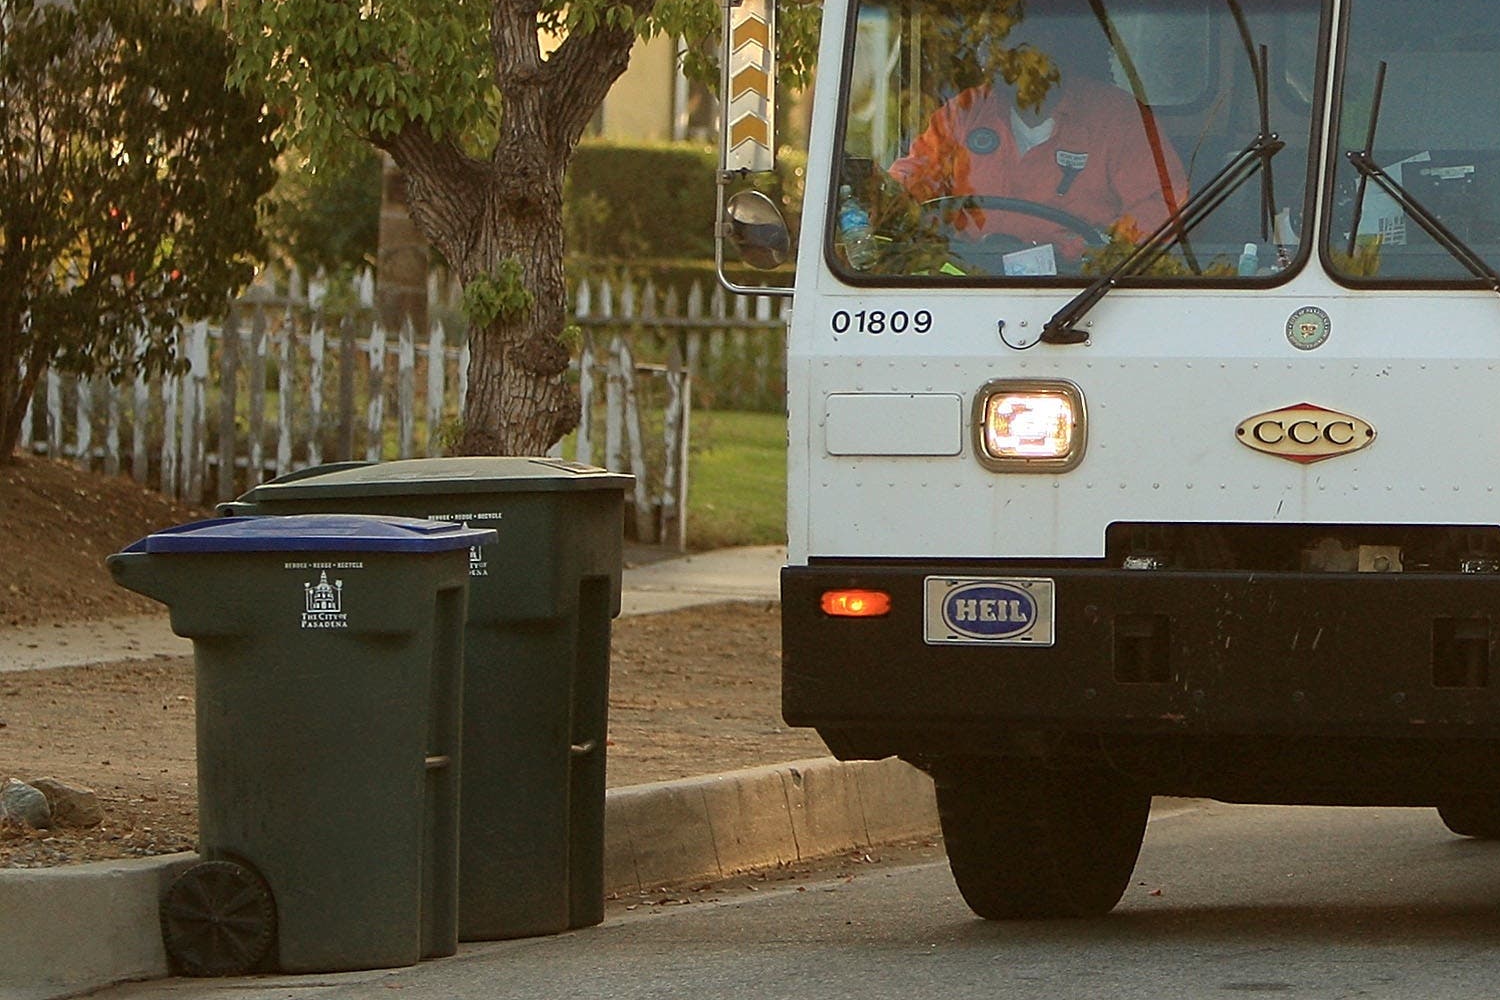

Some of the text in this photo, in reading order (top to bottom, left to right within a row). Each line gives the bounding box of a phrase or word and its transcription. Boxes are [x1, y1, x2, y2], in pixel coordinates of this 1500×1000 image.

[832, 310, 932, 334] 01809
[1253, 421, 1354, 445] CCC
[955, 599, 1027, 622] HEIL
